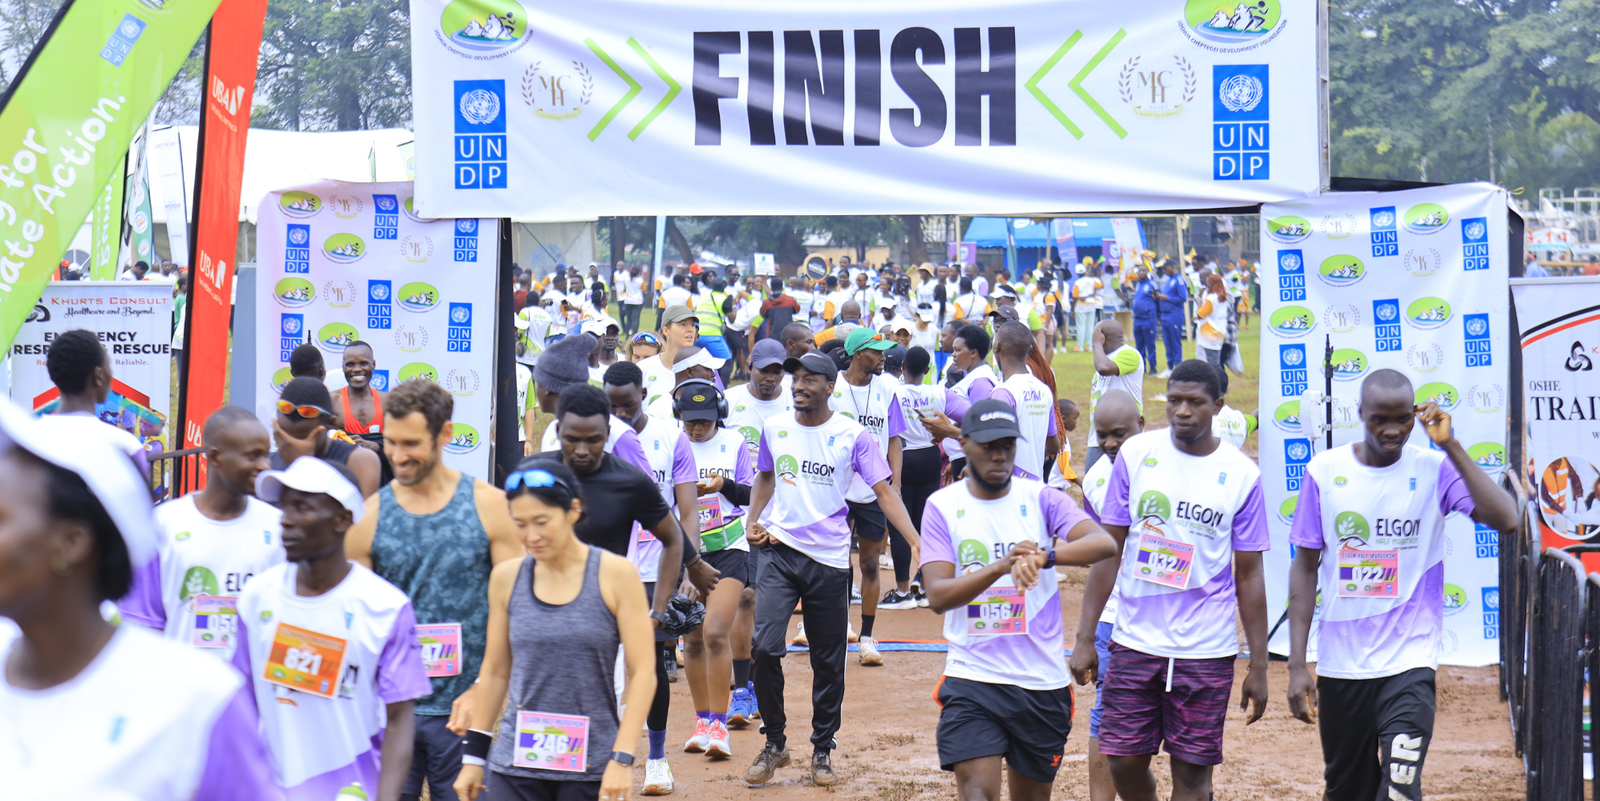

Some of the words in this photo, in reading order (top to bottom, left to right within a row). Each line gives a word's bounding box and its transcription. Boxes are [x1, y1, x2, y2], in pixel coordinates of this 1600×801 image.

[212, 75, 229, 111] UBA
[692, 26, 1017, 147] FINISH
[0, 127, 48, 188] for
[0, 219, 44, 293] ate
[32, 95, 126, 215] Action.
[199, 250, 215, 284] UBA
[51, 297, 103, 306] KHURTS
[110, 296, 168, 305] CONSULT
[121, 306, 155, 317] Beyond.
[113, 344, 169, 354] RESCUE
[115, 358, 149, 366] Reliable.
[1529, 380, 1561, 391] OSHE
[980, 410, 1016, 424] GARMIN
[801, 460, 835, 477] ELGON
[1176, 501, 1224, 527] ELGON
[1174, 519, 1188, 528] HALF
[1189, 520, 1217, 537] MARATHON
[1375, 518, 1421, 537] ELGON
[1375, 537, 1390, 545] HALF
[1148, 552, 1178, 573] 032
[1352, 566, 1383, 583] 022
[979, 603, 1011, 621] 056
[284, 647, 323, 676] 821
[532, 732, 569, 755] 246
